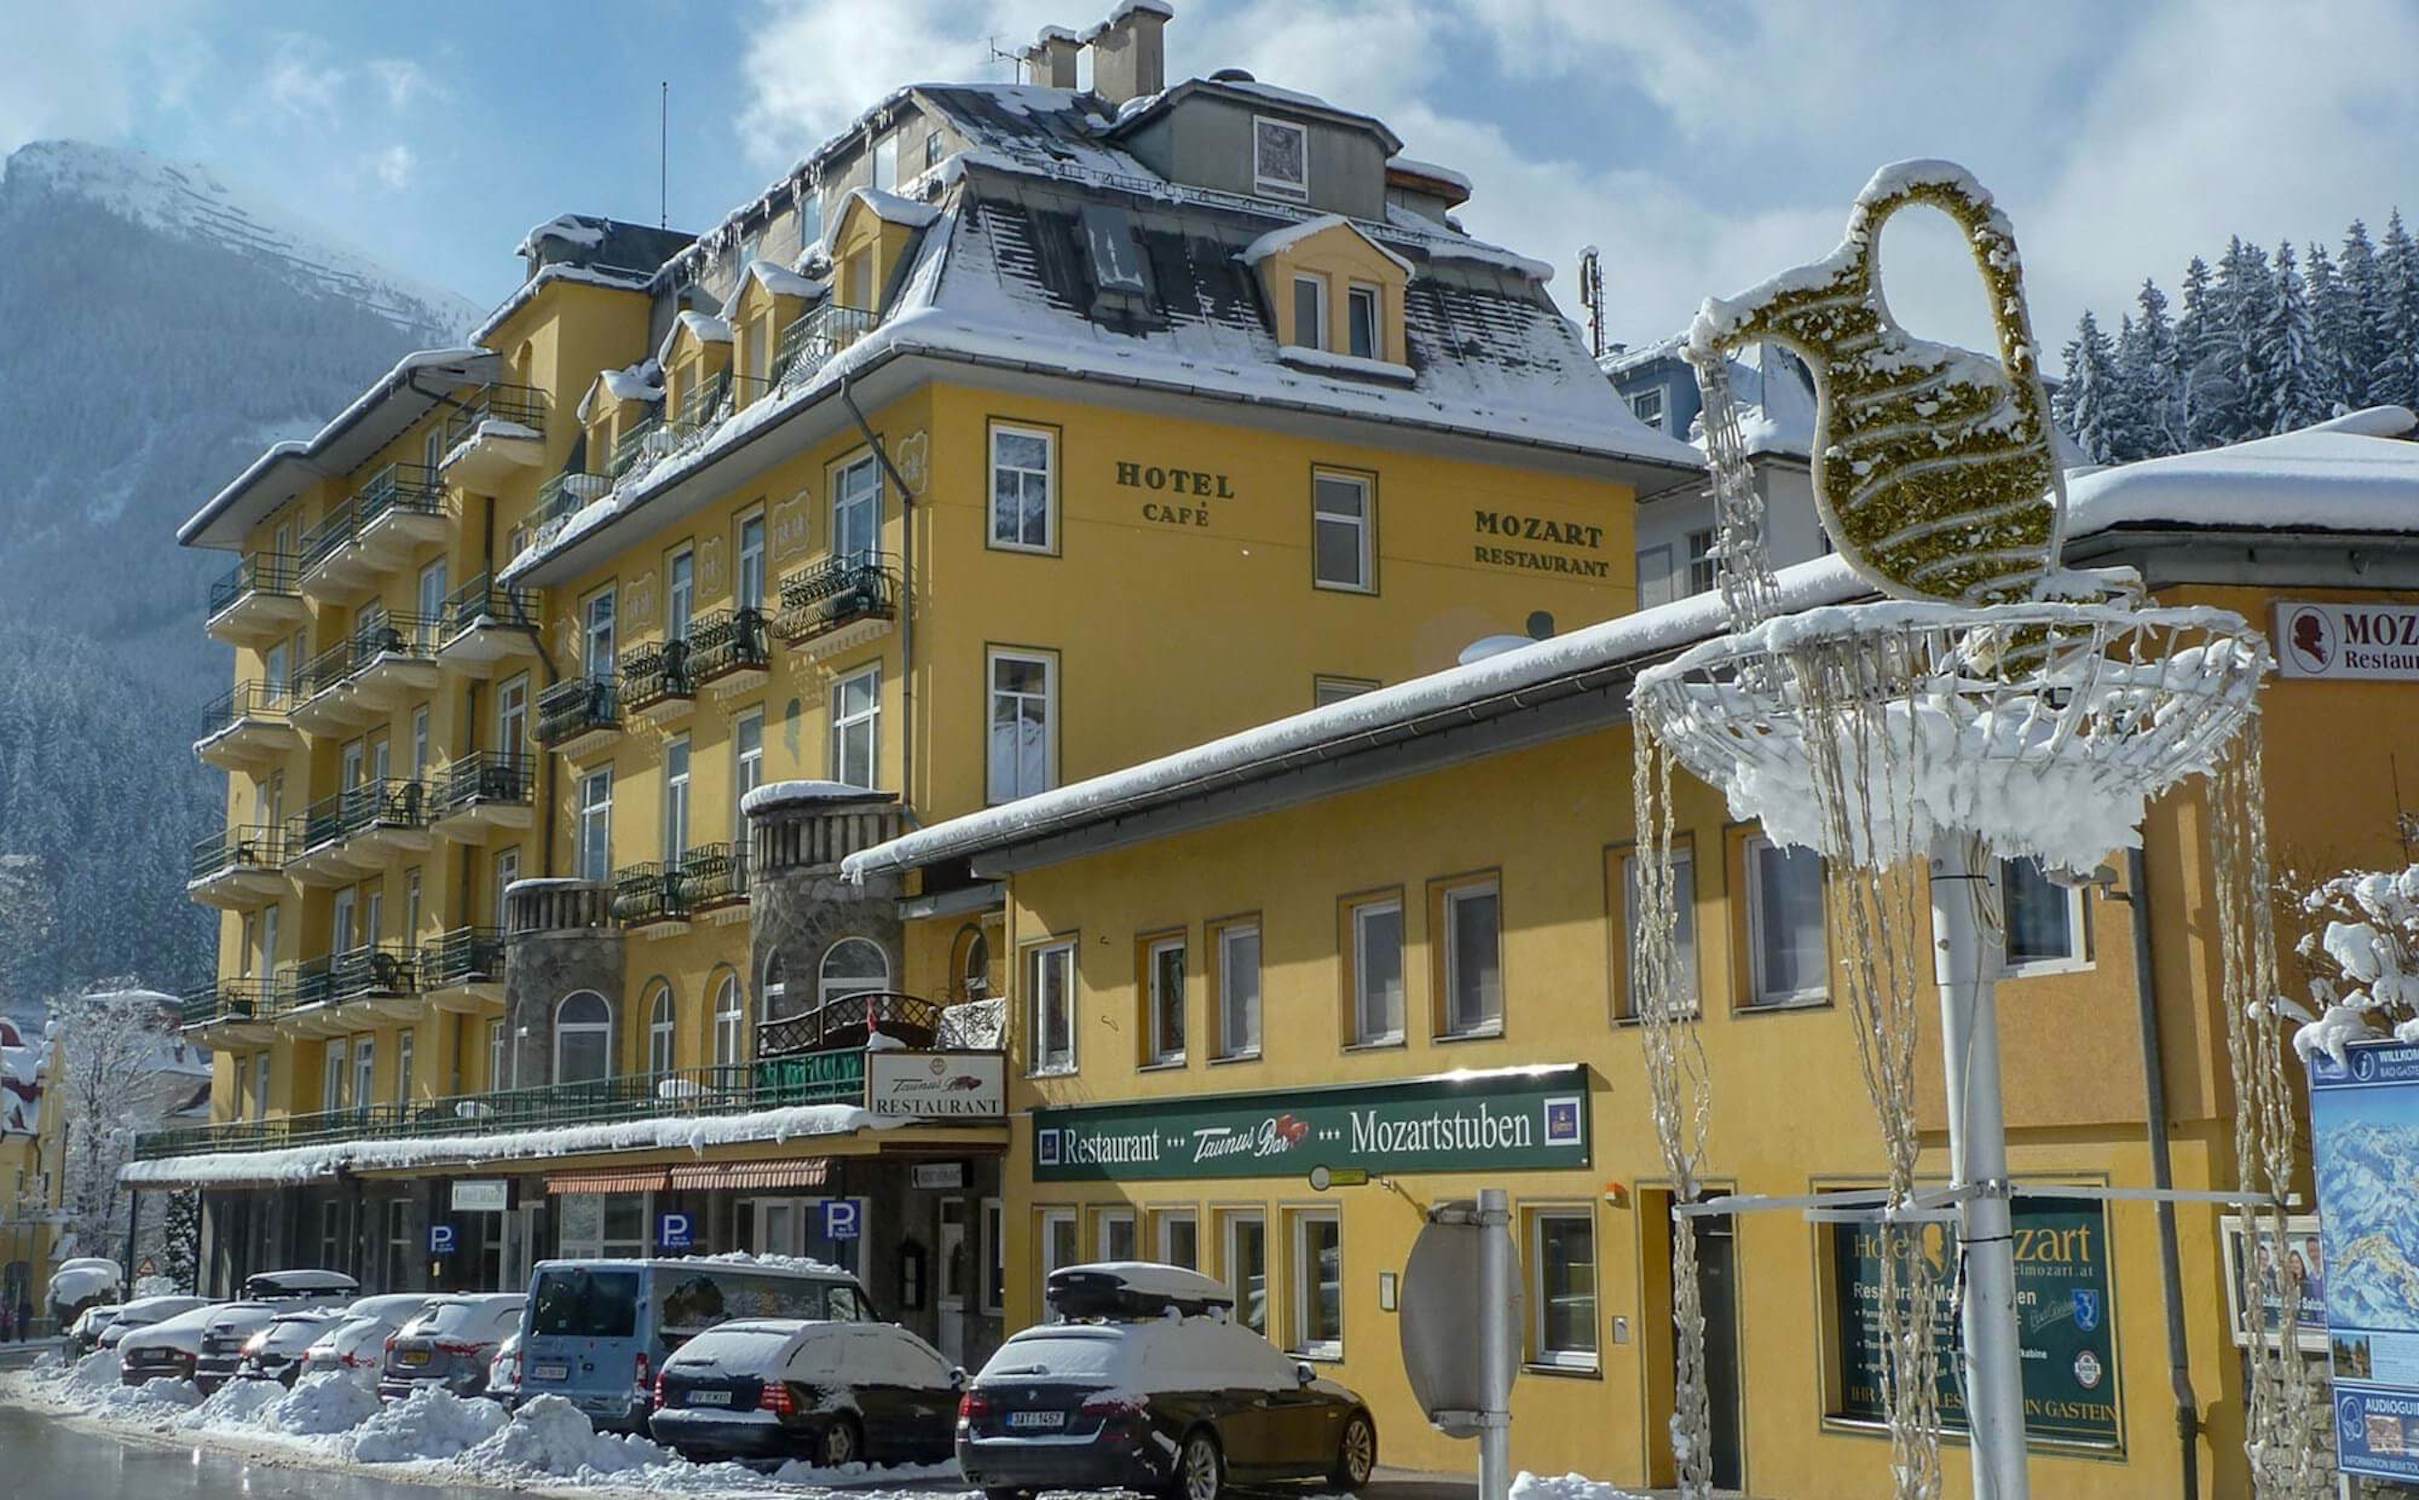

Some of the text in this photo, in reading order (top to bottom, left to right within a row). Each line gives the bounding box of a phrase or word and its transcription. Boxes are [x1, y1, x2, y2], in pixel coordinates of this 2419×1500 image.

[1116, 461, 1235, 499] HOTEL
[1142, 501, 1209, 527] CAFÉ
[1474, 510, 1603, 549] MOZART
[1474, 545, 1609, 578] RESTAURANT
[2344, 613, 2419, 646] MOZ
[877, 1098, 1000, 1114] RESTAURANT
[1064, 1127, 1160, 1165] Restaurant
[1193, 1127, 1254, 1163] Taunus
[1350, 1103, 1532, 1153] Mozartstuben
[663, 1214, 688, 1247] P
[827, 1202, 855, 1238] P
[431, 1226, 452, 1252] P
[2045, 1400, 2117, 1421] GASTEIN
